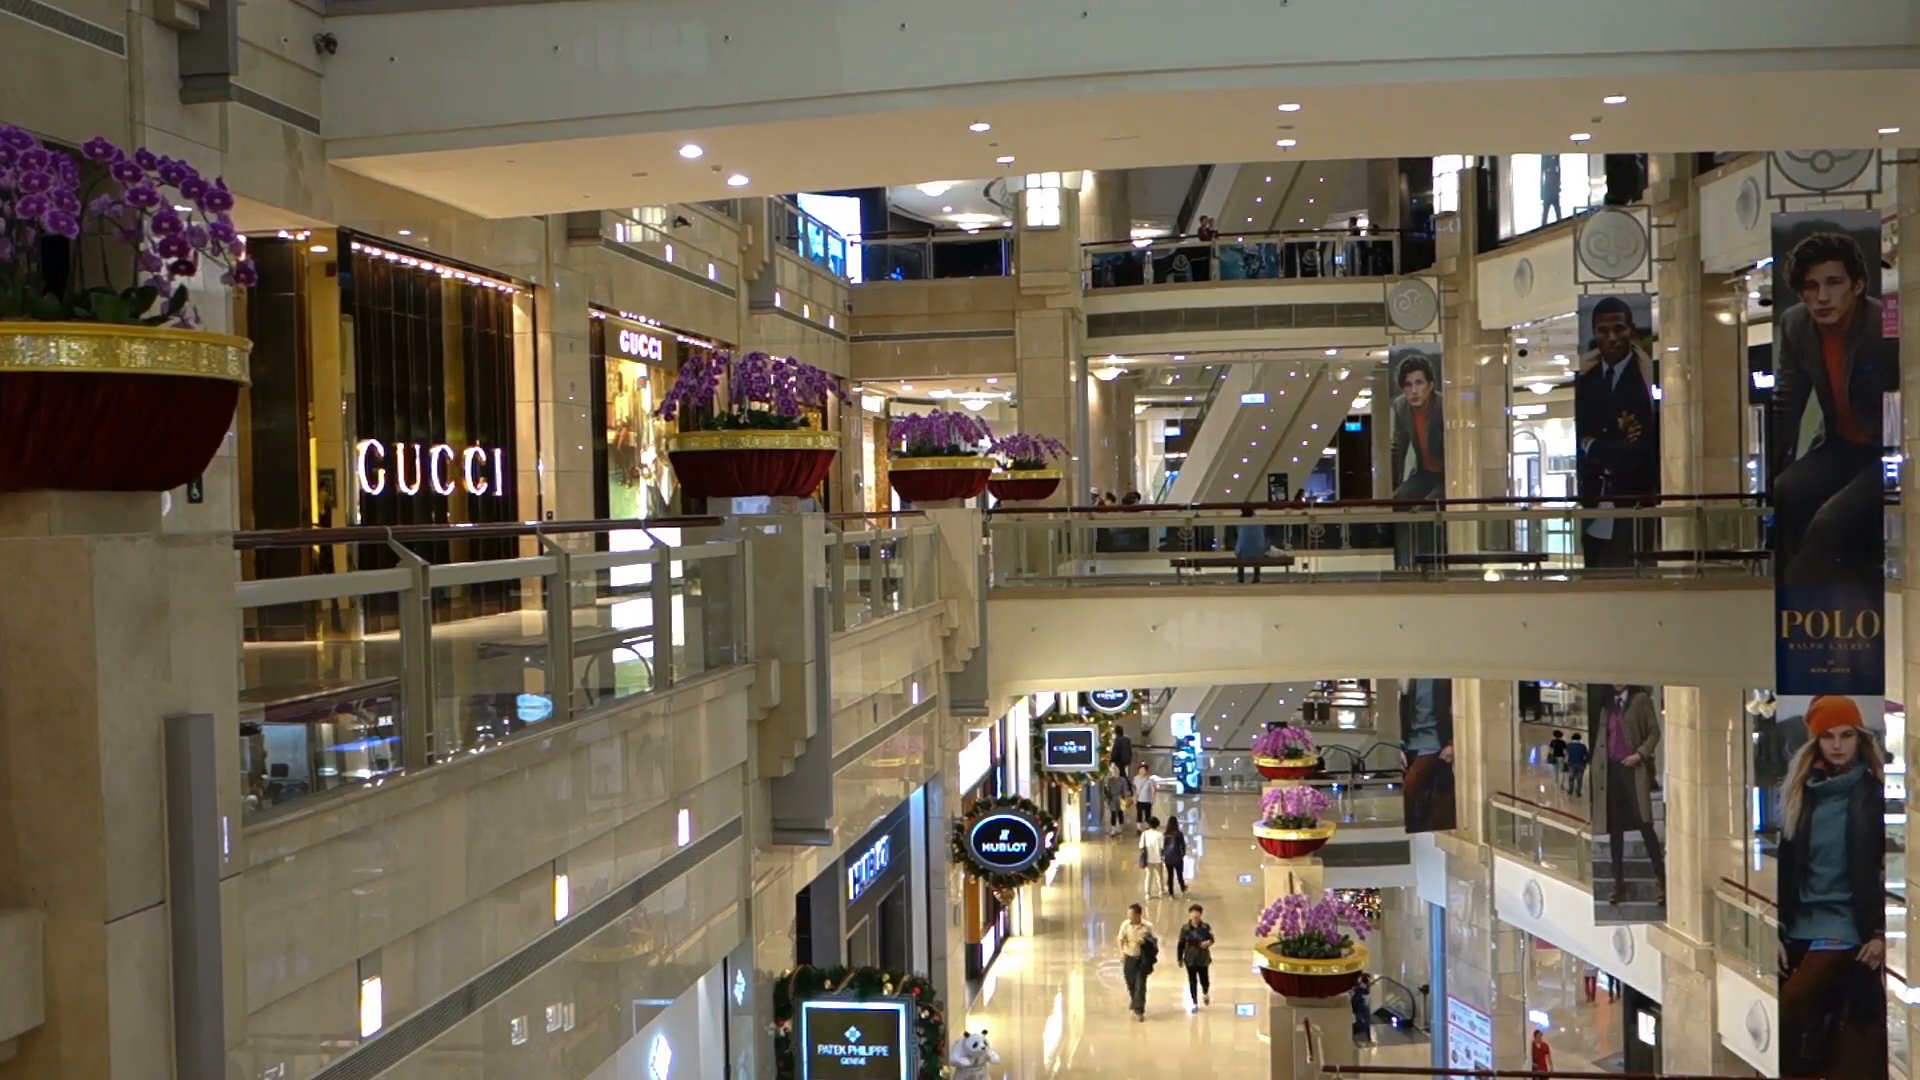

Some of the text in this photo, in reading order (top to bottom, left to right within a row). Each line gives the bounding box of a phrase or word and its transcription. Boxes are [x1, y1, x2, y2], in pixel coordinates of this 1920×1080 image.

[619, 329, 662, 361] GUCCI
[356, 438, 503, 496] GUCCI
[1781, 609, 1880, 639] POLO
[981, 842, 1028, 852] HUBLOT
[817, 1044, 889, 1057] PATEK PHILIPPE
